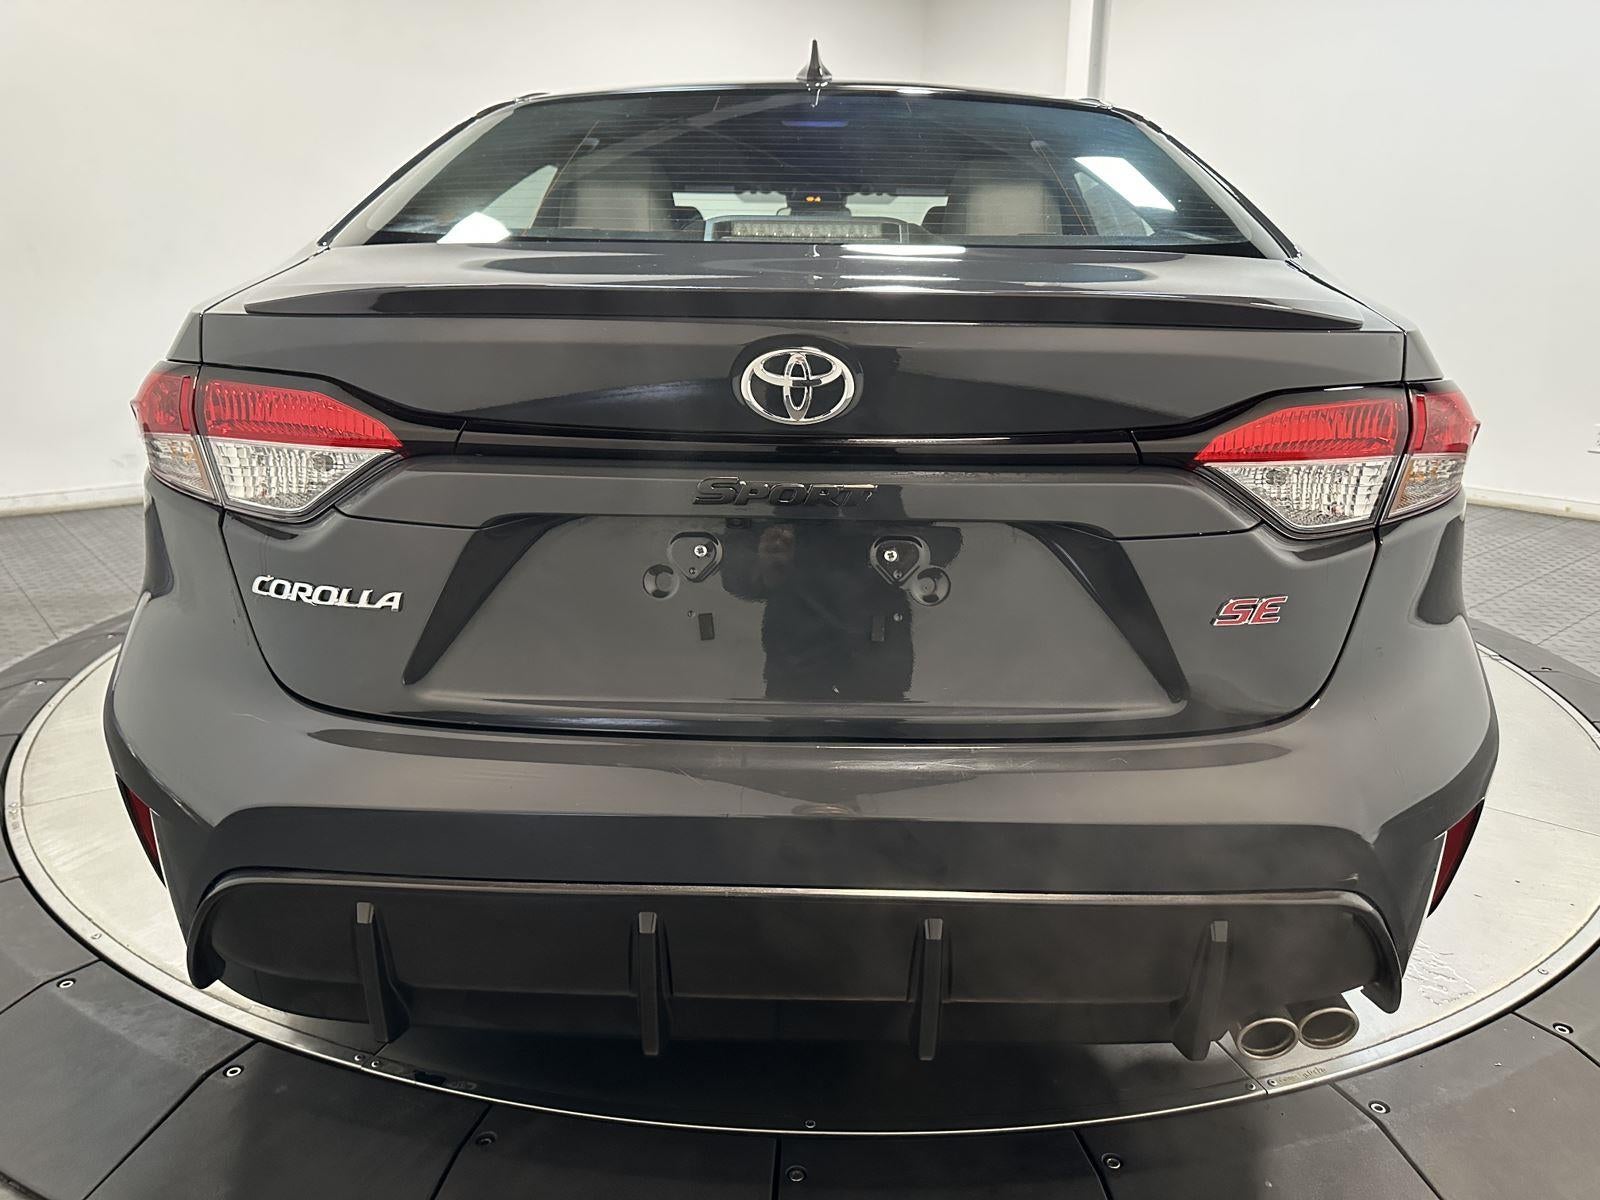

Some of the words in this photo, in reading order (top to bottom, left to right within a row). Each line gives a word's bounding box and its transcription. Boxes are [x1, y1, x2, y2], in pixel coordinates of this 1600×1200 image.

[693, 476, 878, 506] SPORT
[251, 575, 403, 612] COROLLA
[1212, 595, 1288, 626] SE
